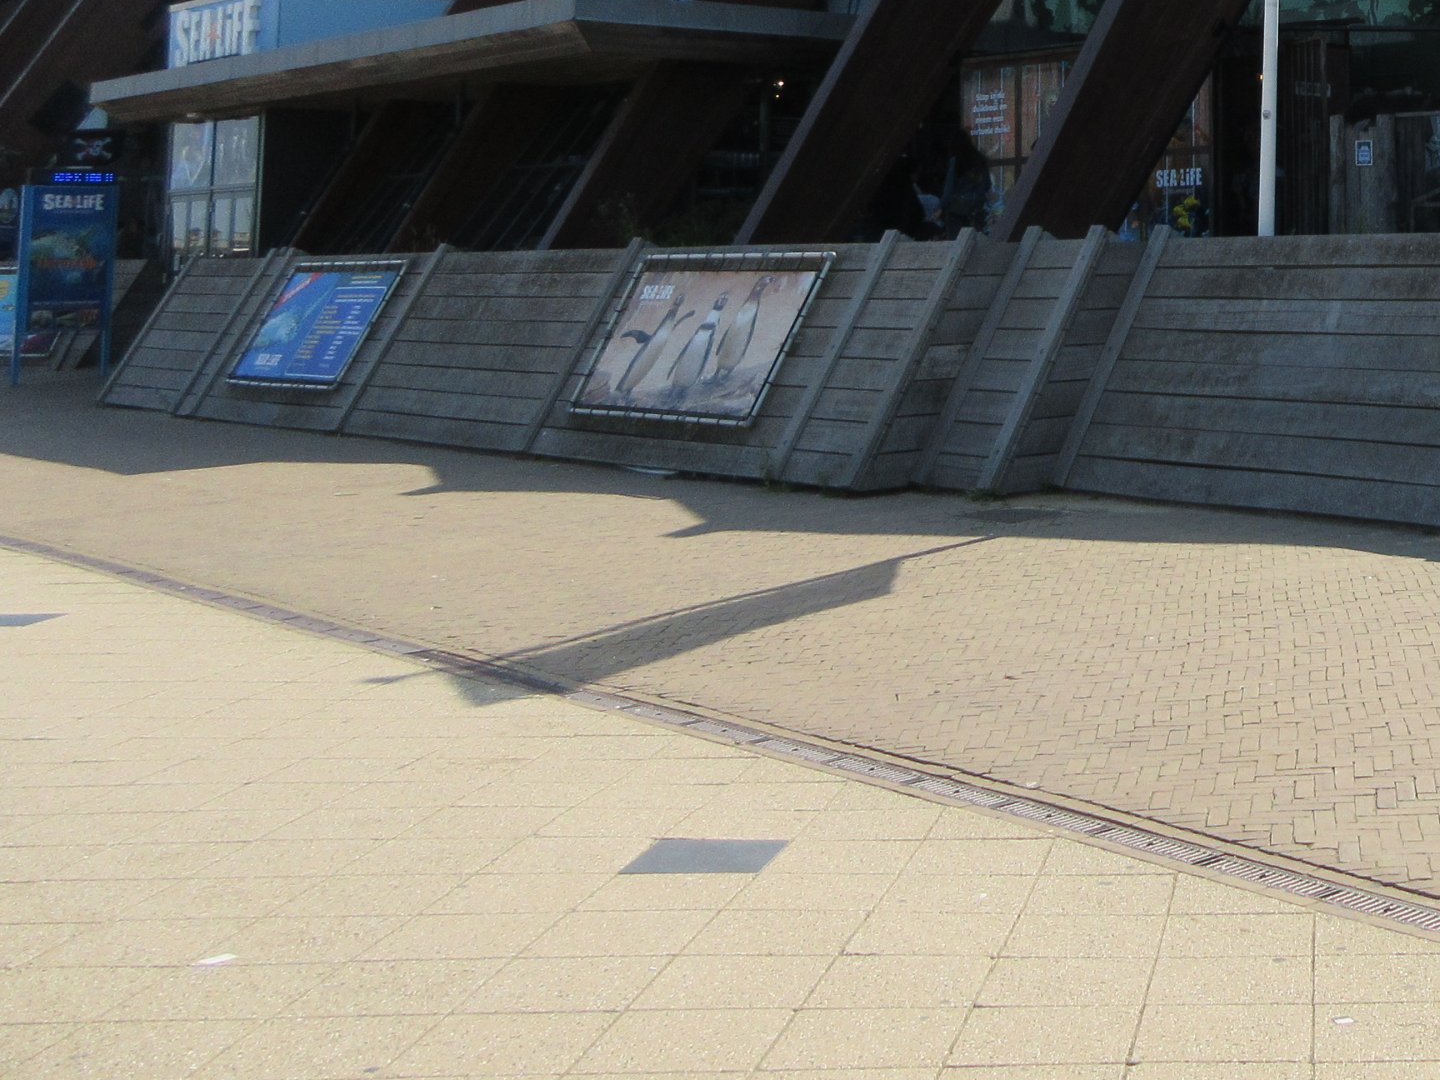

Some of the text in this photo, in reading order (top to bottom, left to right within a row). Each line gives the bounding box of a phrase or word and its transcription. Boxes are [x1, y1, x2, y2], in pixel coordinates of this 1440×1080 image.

[175, 9, 211, 67] SEA
[1156, 168, 1177, 188] SEA
[42, 193, 72, 210] SEA
